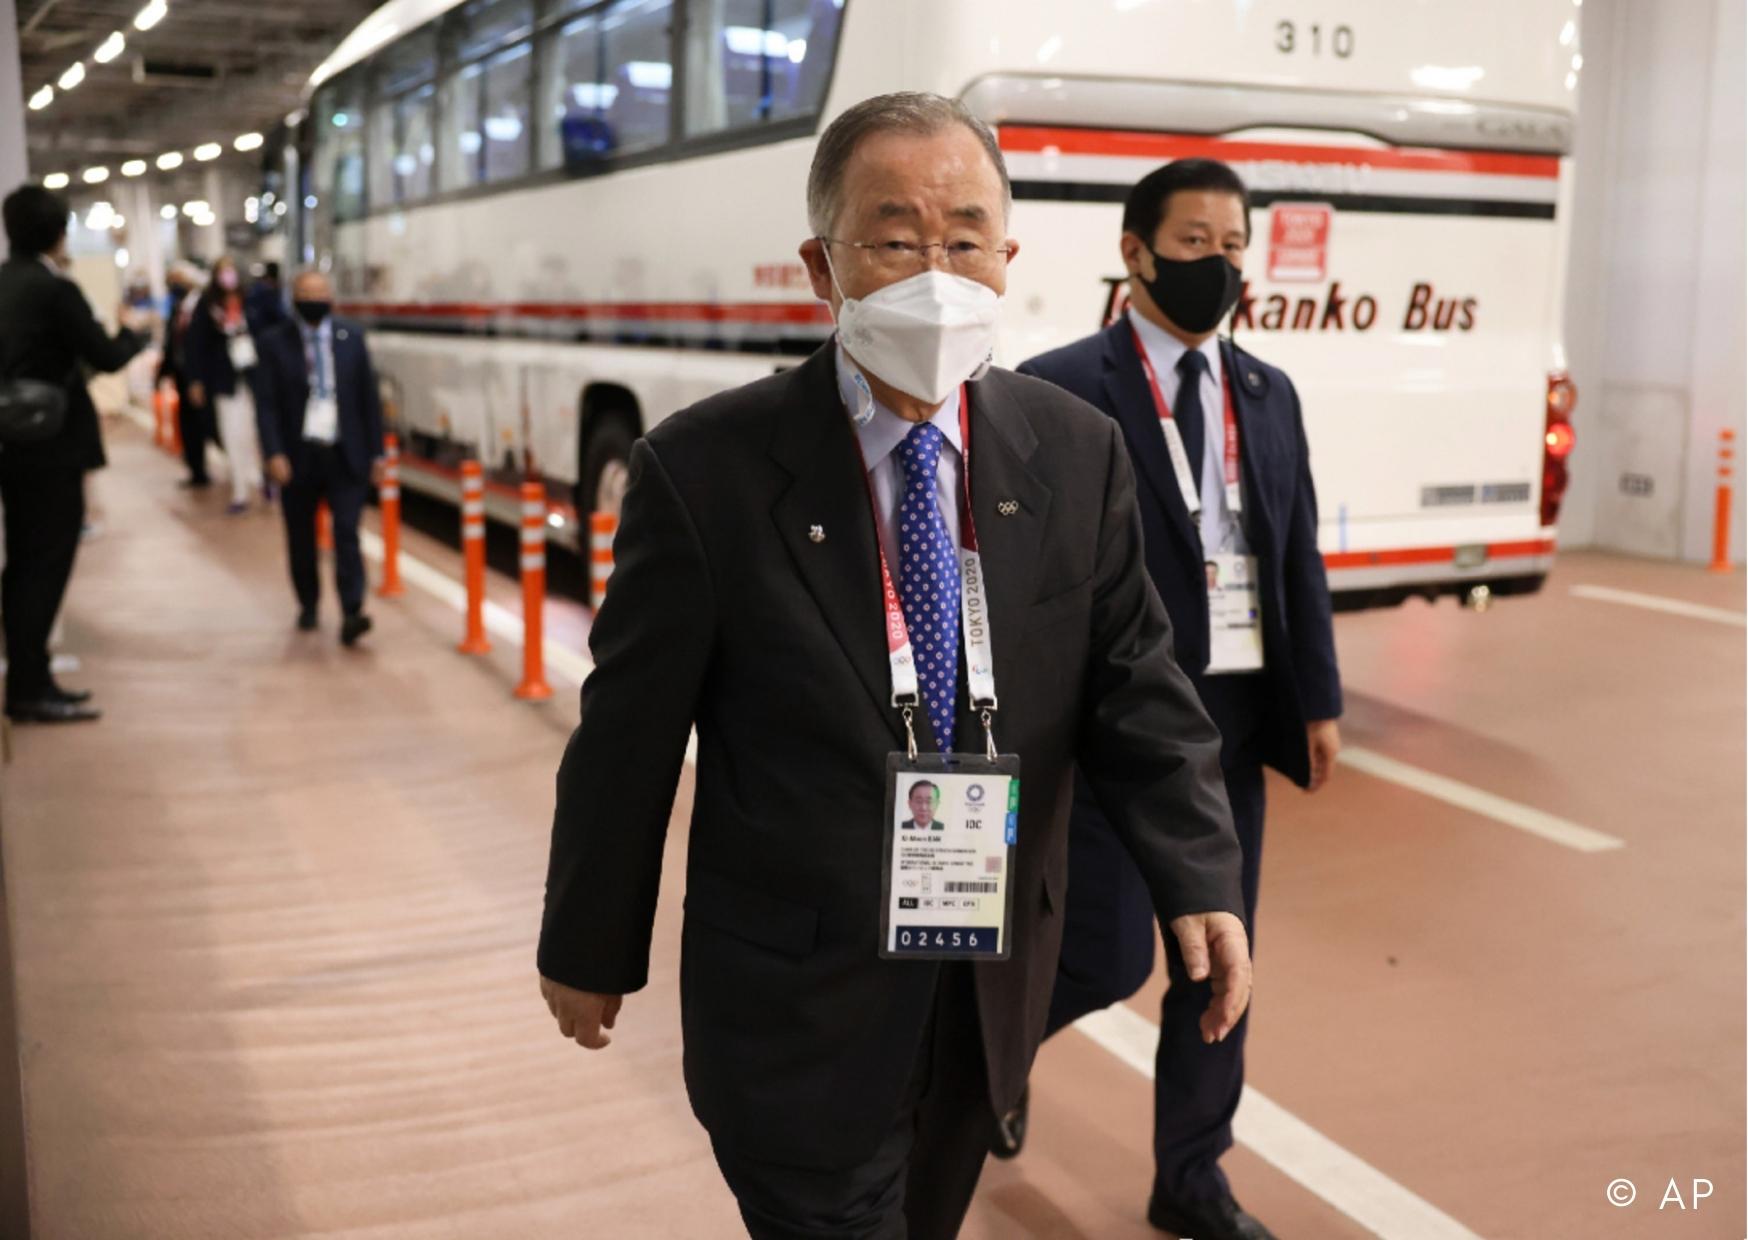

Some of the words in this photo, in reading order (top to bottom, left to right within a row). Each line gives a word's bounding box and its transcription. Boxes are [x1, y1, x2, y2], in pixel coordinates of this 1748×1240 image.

[1276, 20, 1355, 58] 310
[1402, 282, 1479, 334] Bus
[964, 557, 979, 593] 2020
[968, 600, 984, 647] TOKYO
[901, 931, 978, 947] 02456
